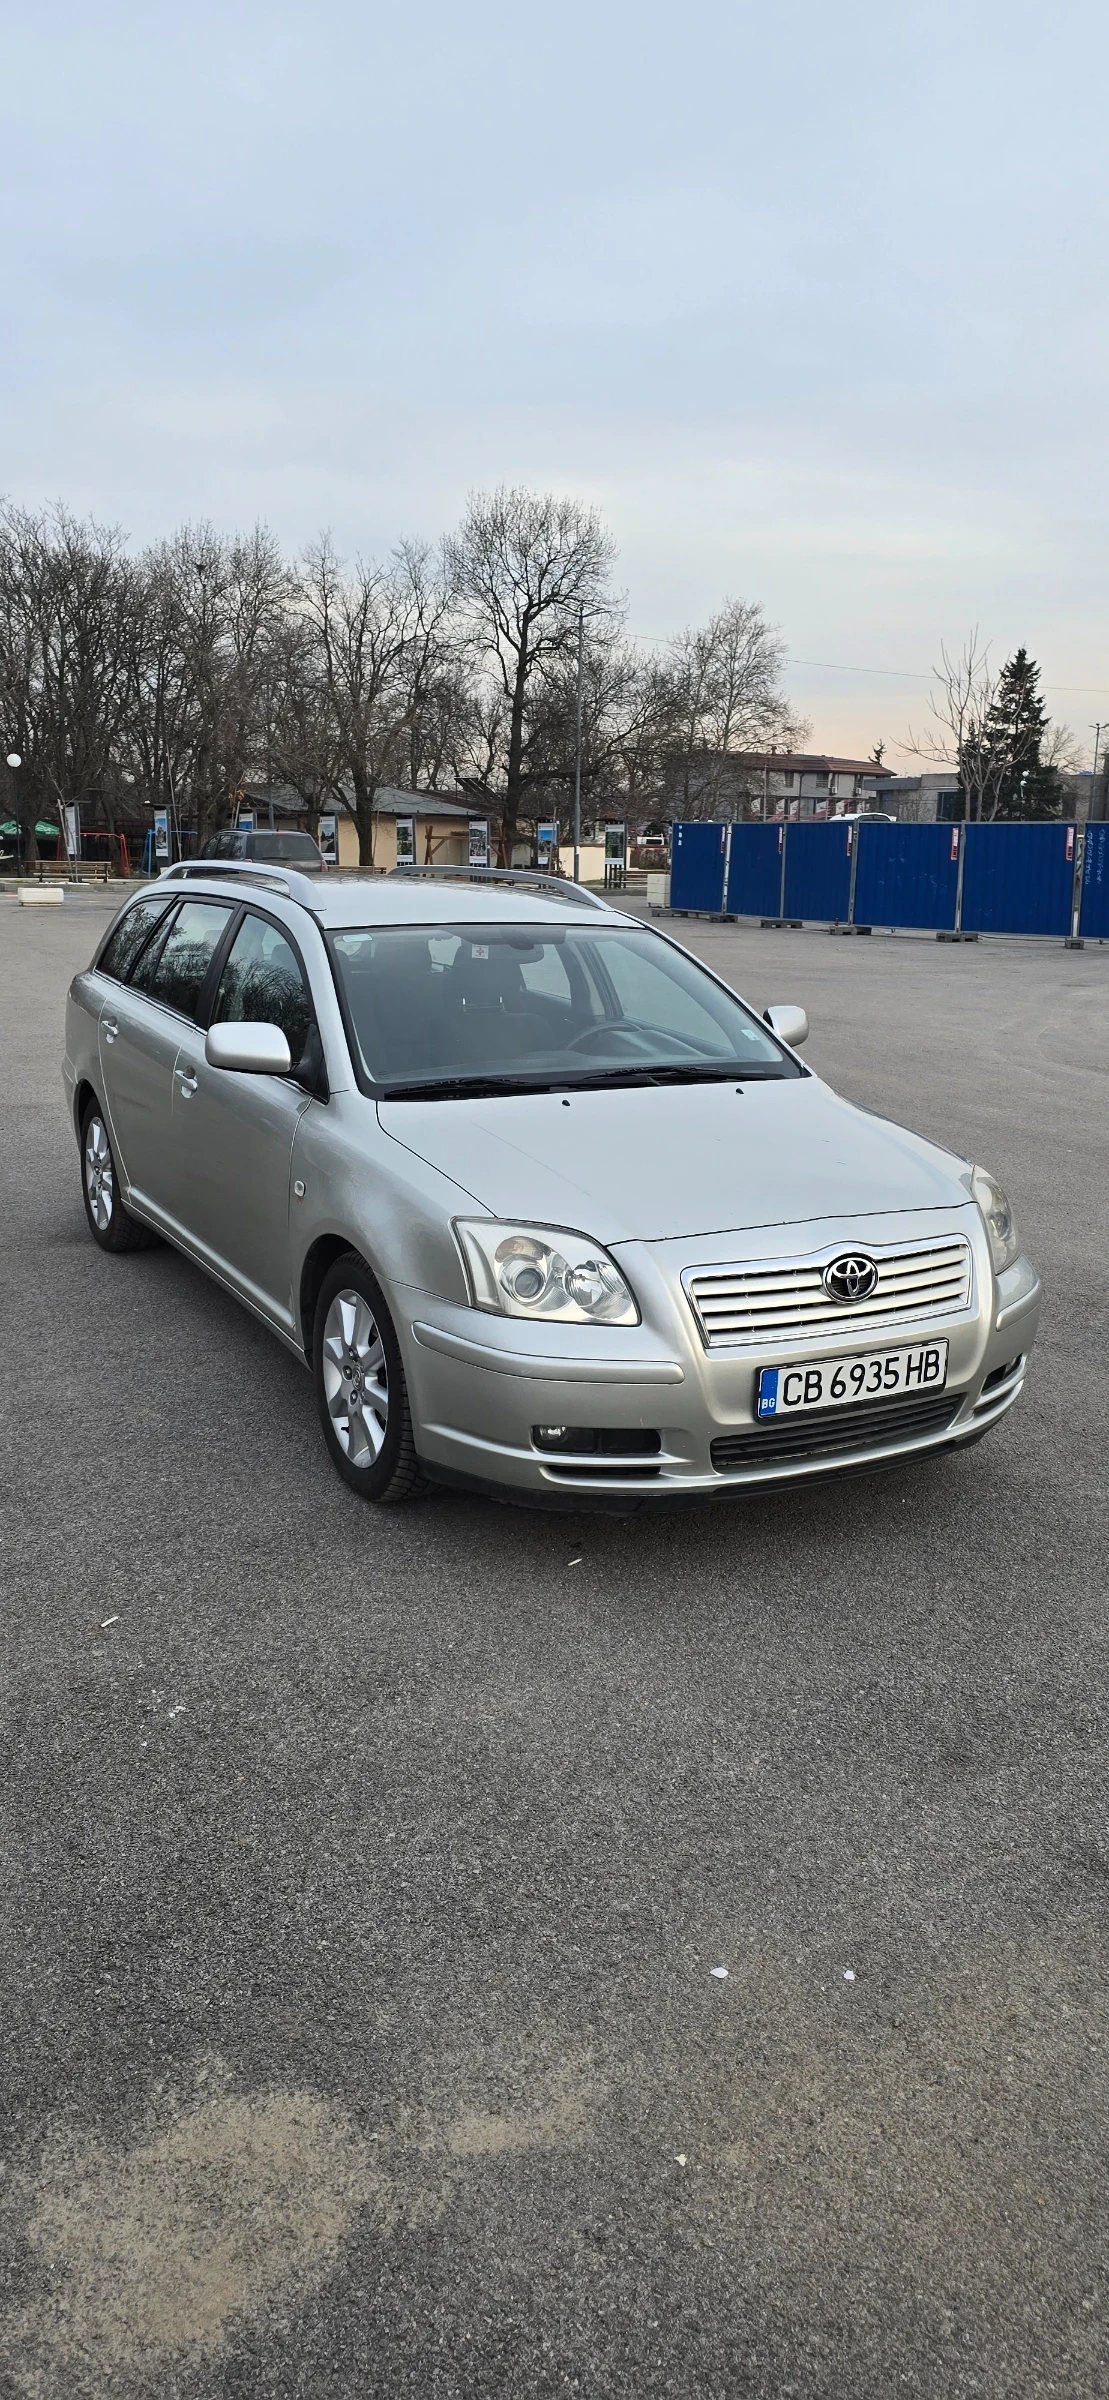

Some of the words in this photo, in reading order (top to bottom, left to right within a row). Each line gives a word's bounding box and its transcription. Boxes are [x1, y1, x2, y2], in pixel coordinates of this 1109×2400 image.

[783, 1370, 822, 1406] CB
[830, 1357, 900, 1399] 6935
[905, 1349, 940, 1386] HB
[761, 1398, 775, 1410] BG
